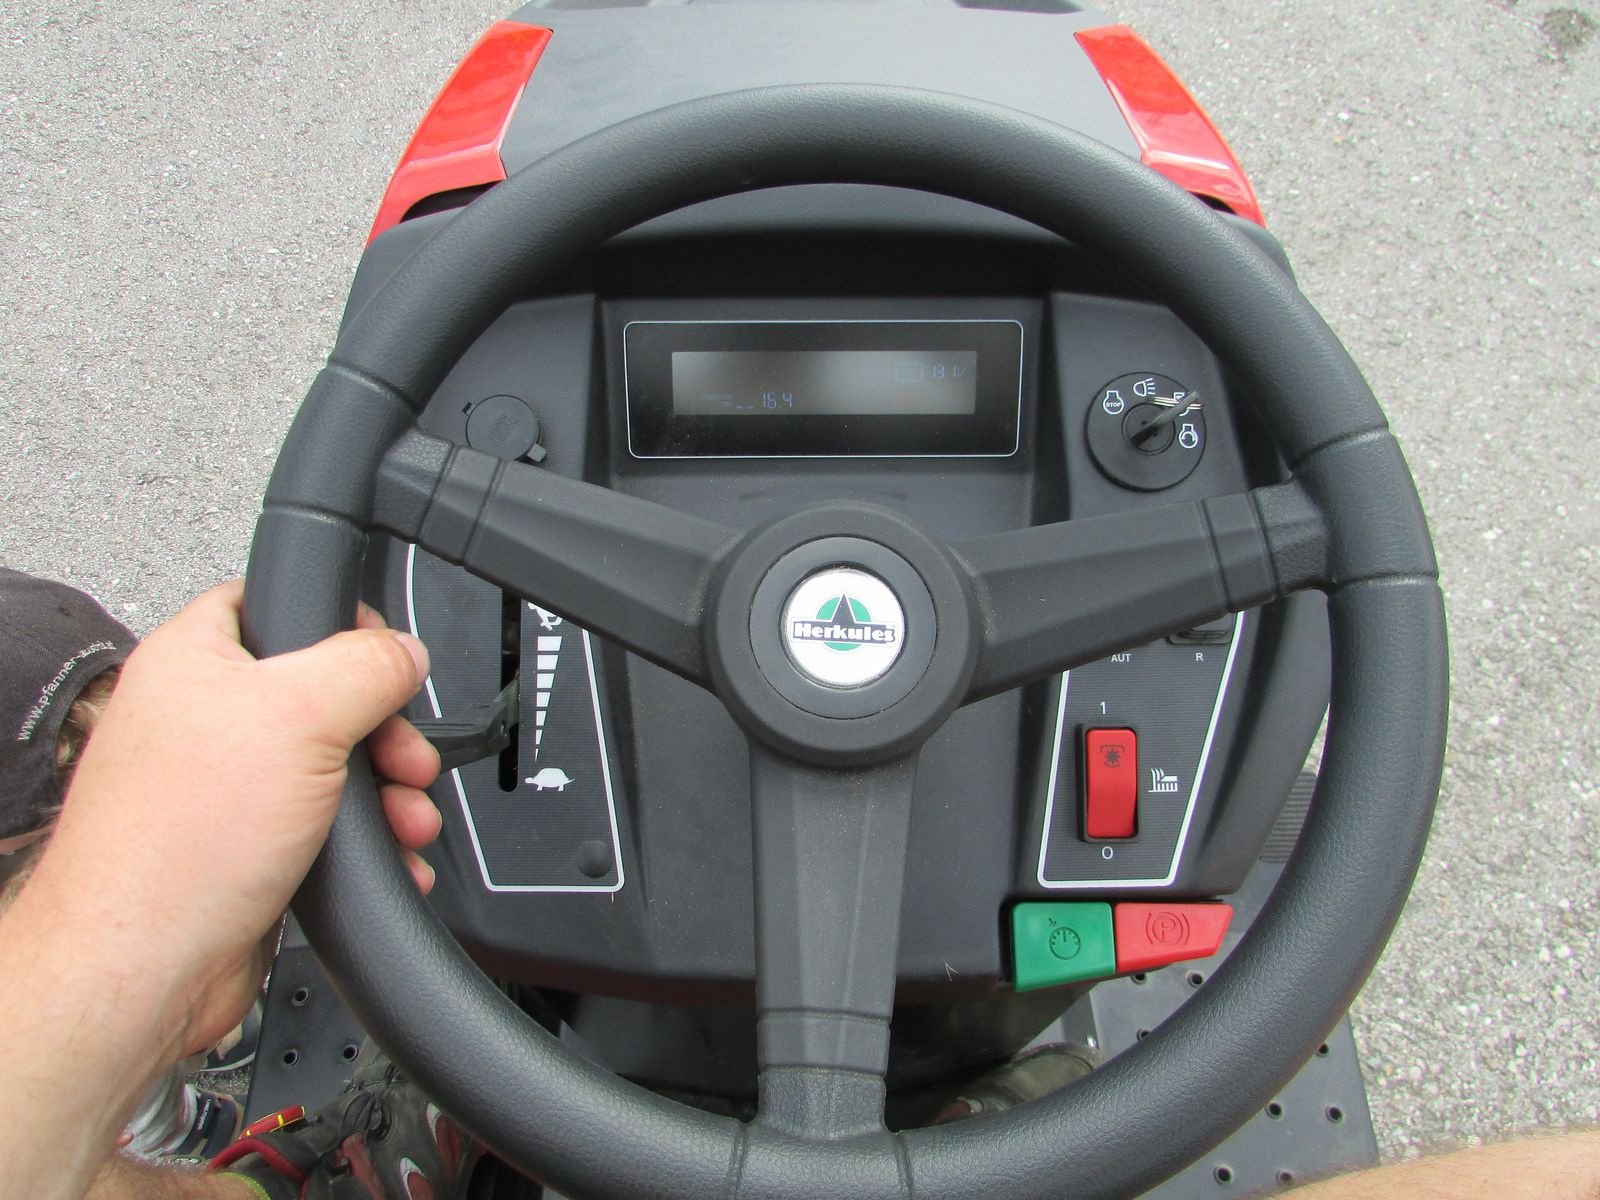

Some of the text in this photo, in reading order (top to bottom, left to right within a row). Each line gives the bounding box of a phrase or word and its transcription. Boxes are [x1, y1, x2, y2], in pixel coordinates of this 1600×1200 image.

[793, 622, 896, 643] Herkules
[1110, 653, 1132, 663] AUT
[1195, 652, 1204, 662] R
[1100, 701, 1107, 715] 1
